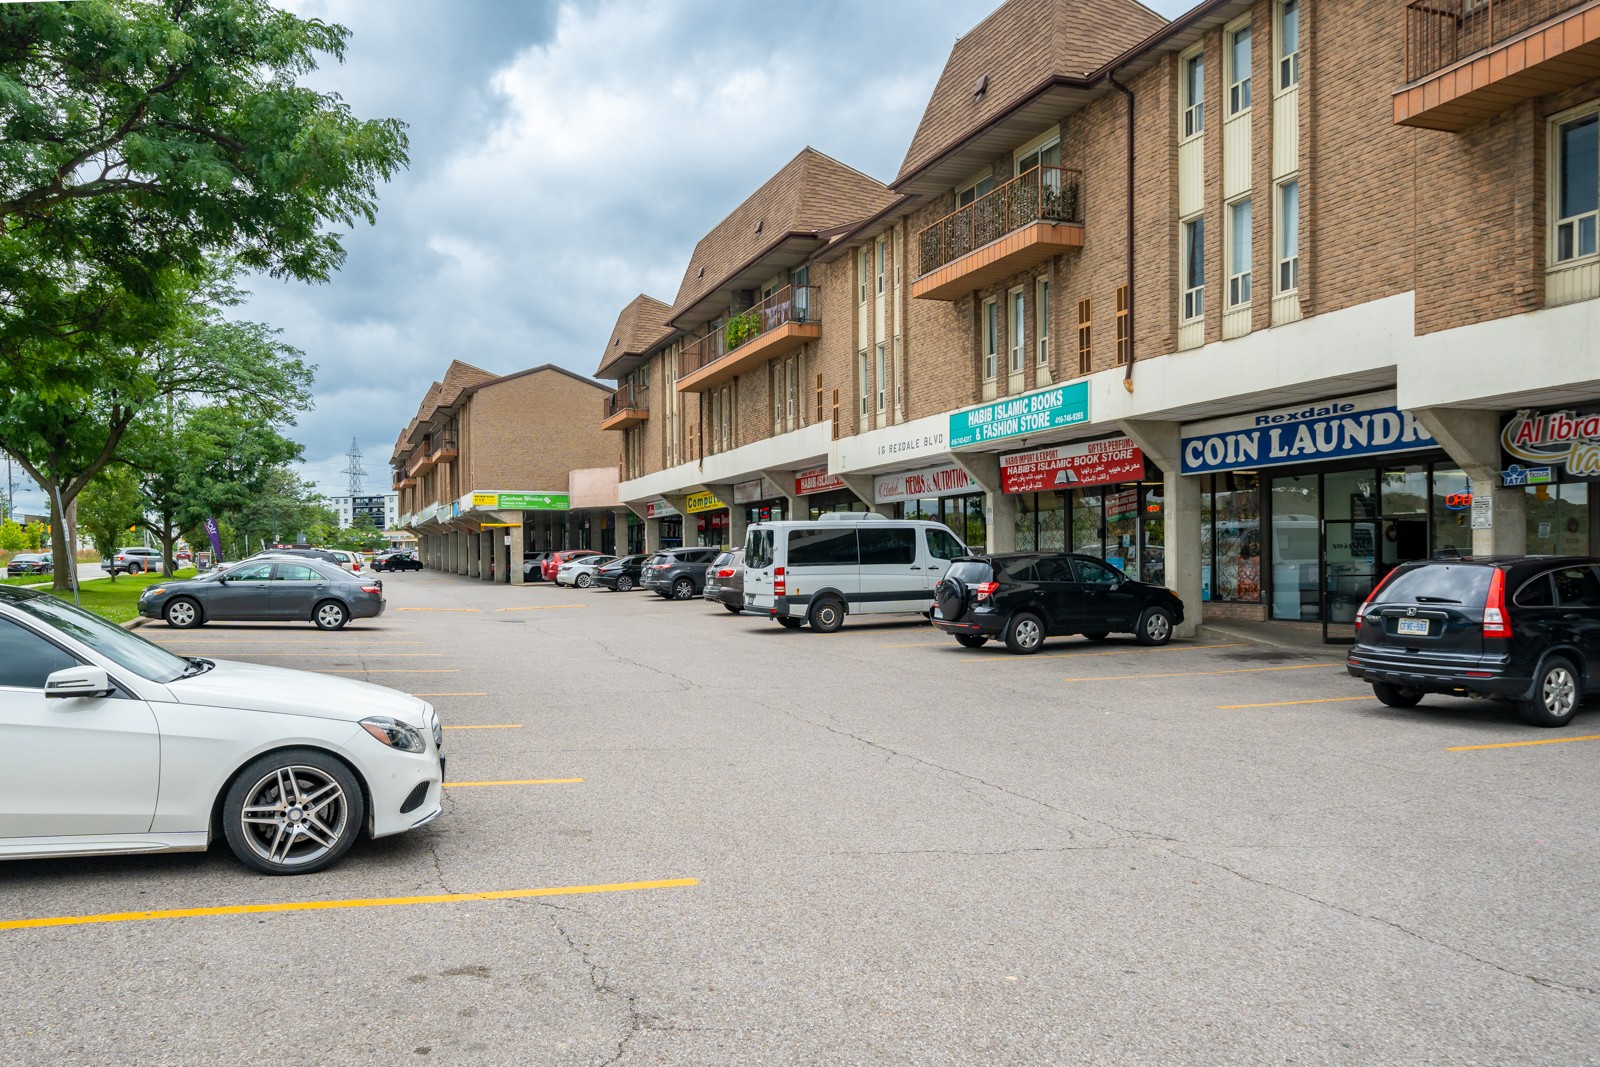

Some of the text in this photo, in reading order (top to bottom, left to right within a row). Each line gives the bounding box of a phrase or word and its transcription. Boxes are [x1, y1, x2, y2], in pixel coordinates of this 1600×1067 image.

[968, 390, 1063, 426] HABIB ISLAMIC BOOKS
[1255, 402, 1356, 426] Rexdale
[976, 412, 1050, 440] & FASHION STORE
[1516, 417, 1542, 444] Al
[888, 438, 920, 454] REXDALE
[924, 434, 944, 446] BLVD
[1040, 450, 1058, 461] EXPORT
[1088, 441, 1102, 454] GIFTS
[1185, 432, 1260, 468] COIN
[1008, 450, 1132, 476] HABIB'S ISLAMIC BOOK STORE
[800, 476, 816, 490] HABIB
[906, 474, 926, 495] HERBS
[926, 478, 932, 492] &
[932, 468, 968, 492] NUTRITION
